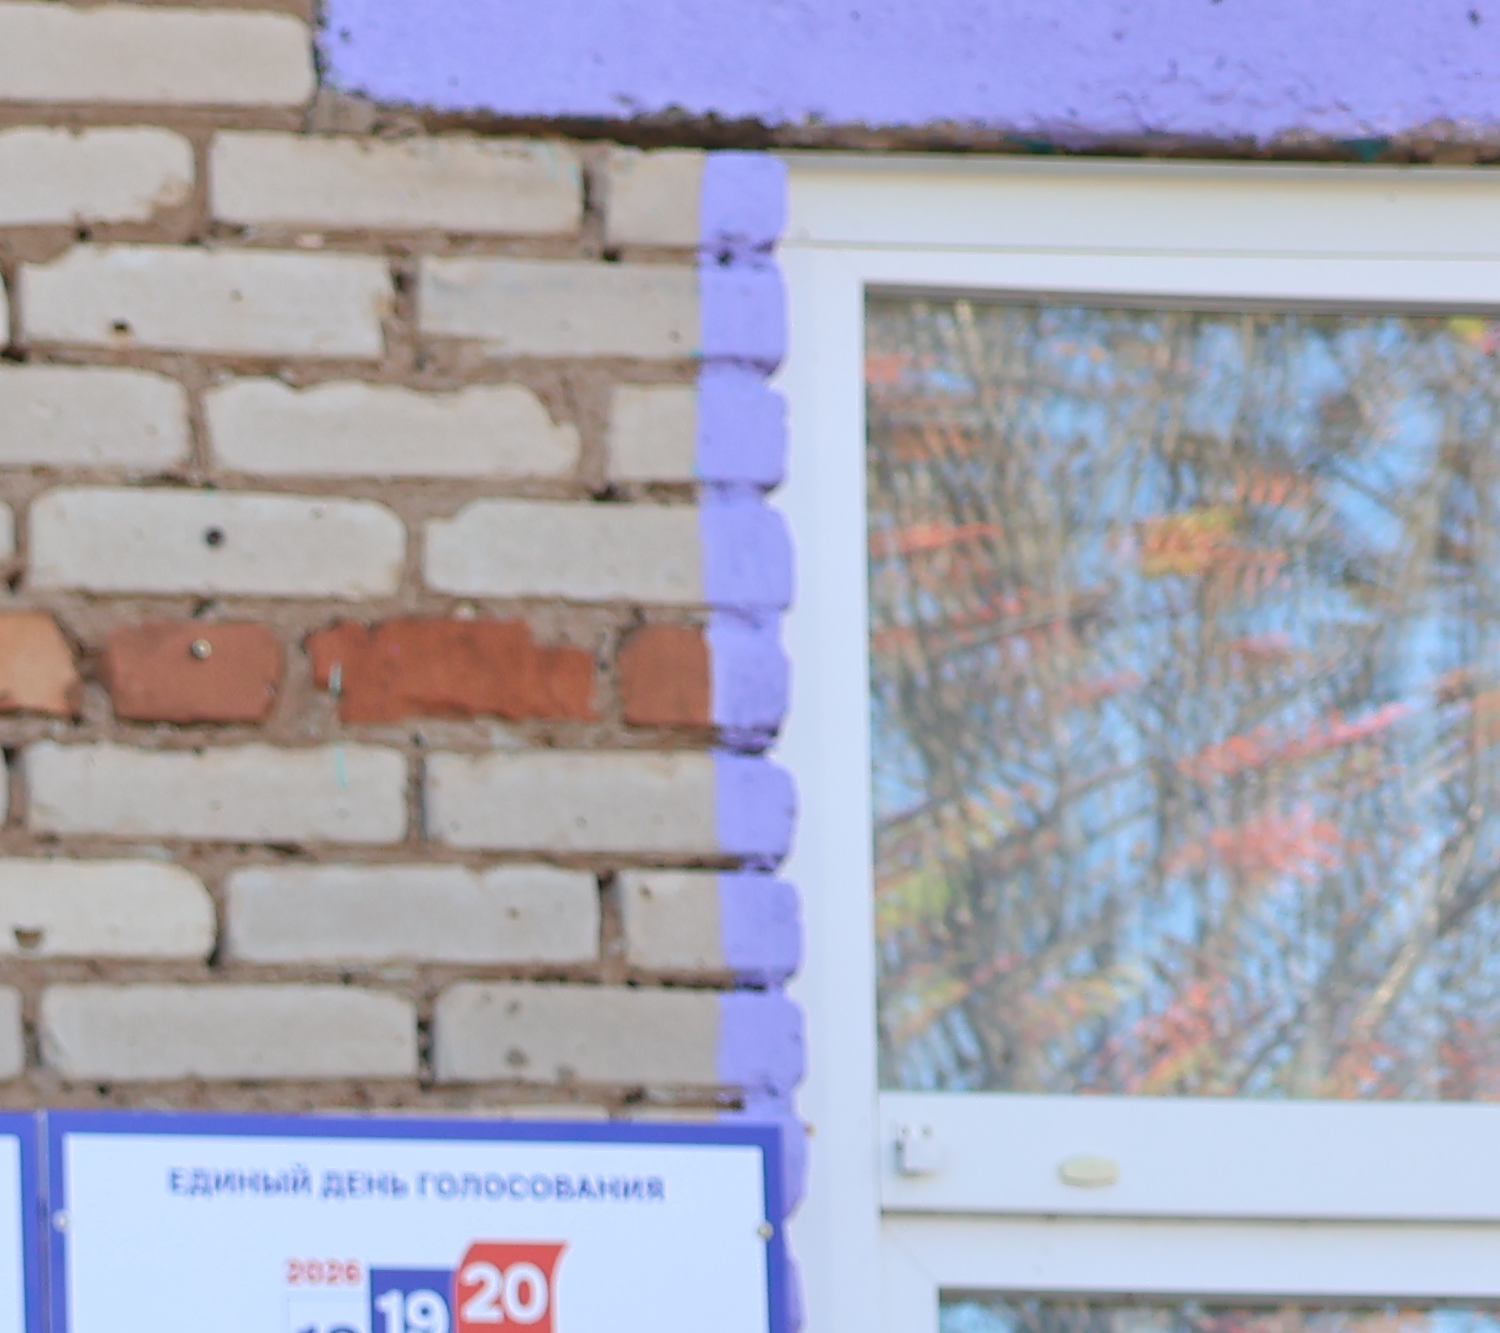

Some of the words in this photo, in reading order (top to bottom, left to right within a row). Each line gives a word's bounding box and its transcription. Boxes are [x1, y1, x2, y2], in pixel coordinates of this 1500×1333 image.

[169, 1164, 311, 1196] ЕДИНЫЙ
[322, 1172, 409, 1198] ДЕНЬ
[418, 1173, 664, 1200] ГОЛОСОВАНИЯ
[287, 1261, 360, 1284] 2026
[460, 1259, 549, 1324] 20
